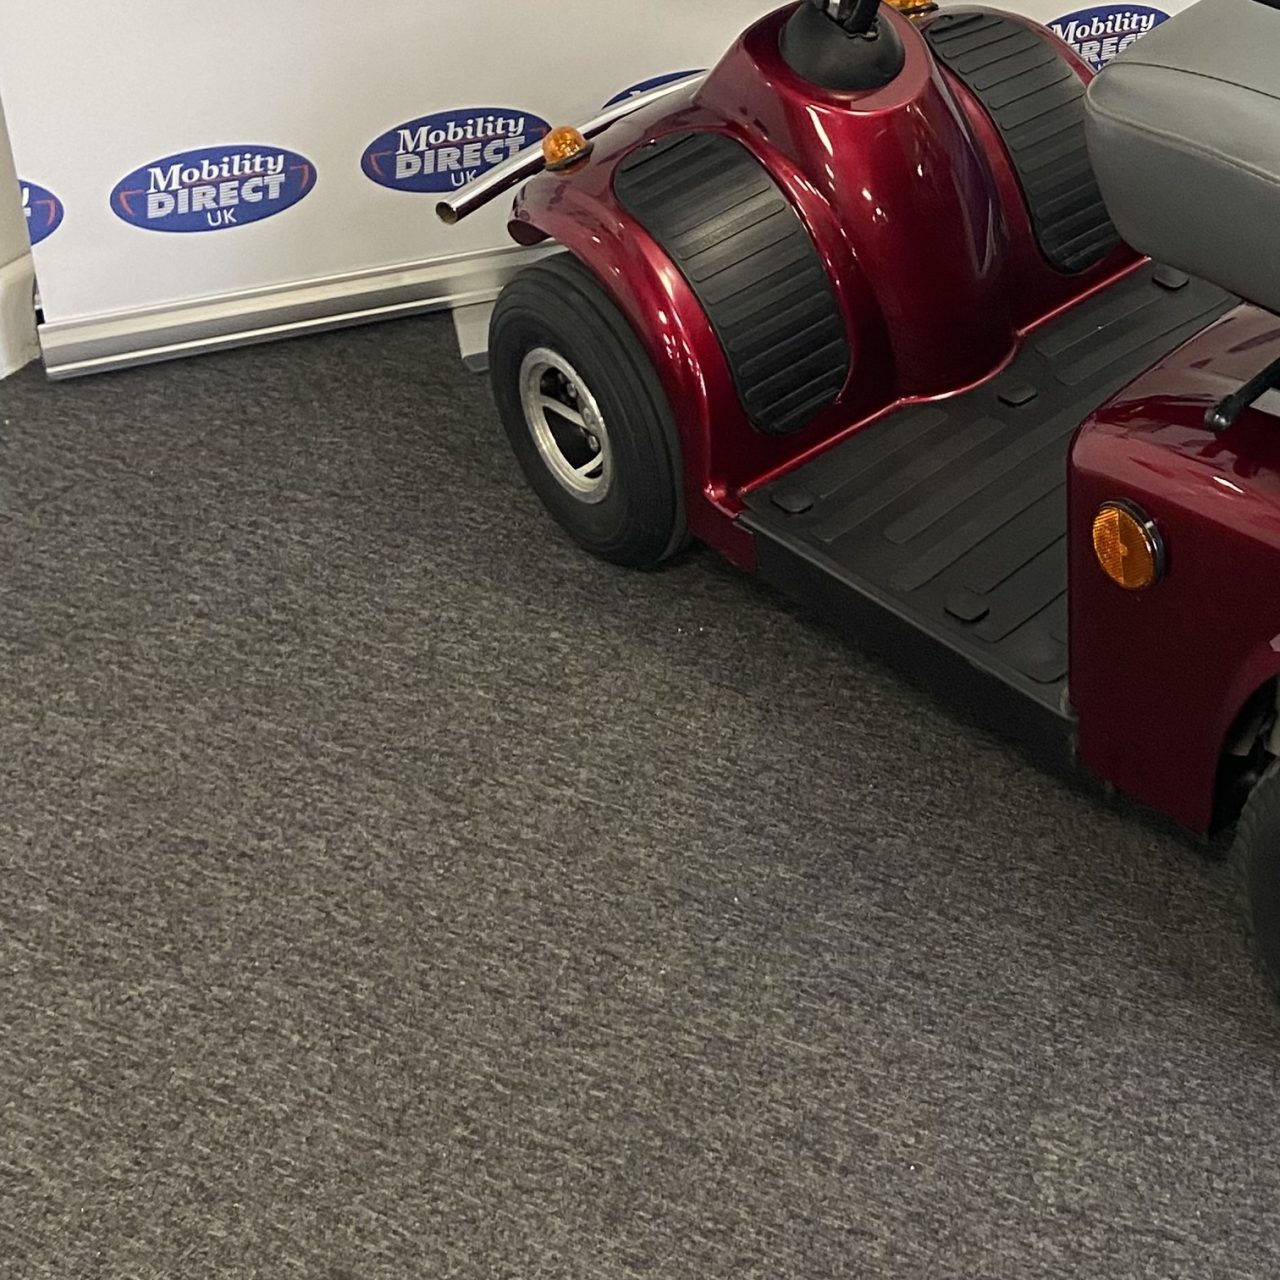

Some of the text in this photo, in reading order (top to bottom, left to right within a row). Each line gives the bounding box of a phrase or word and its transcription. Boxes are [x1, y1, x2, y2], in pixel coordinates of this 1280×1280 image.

[1051, 12, 1155, 44] Mobility
[396, 115, 525, 155] Mobility
[147, 152, 286, 193] Mobility
[395, 135, 525, 179] DIRECT
[145, 179, 283, 220] DIRECT
[207, 206, 237, 226] UK
